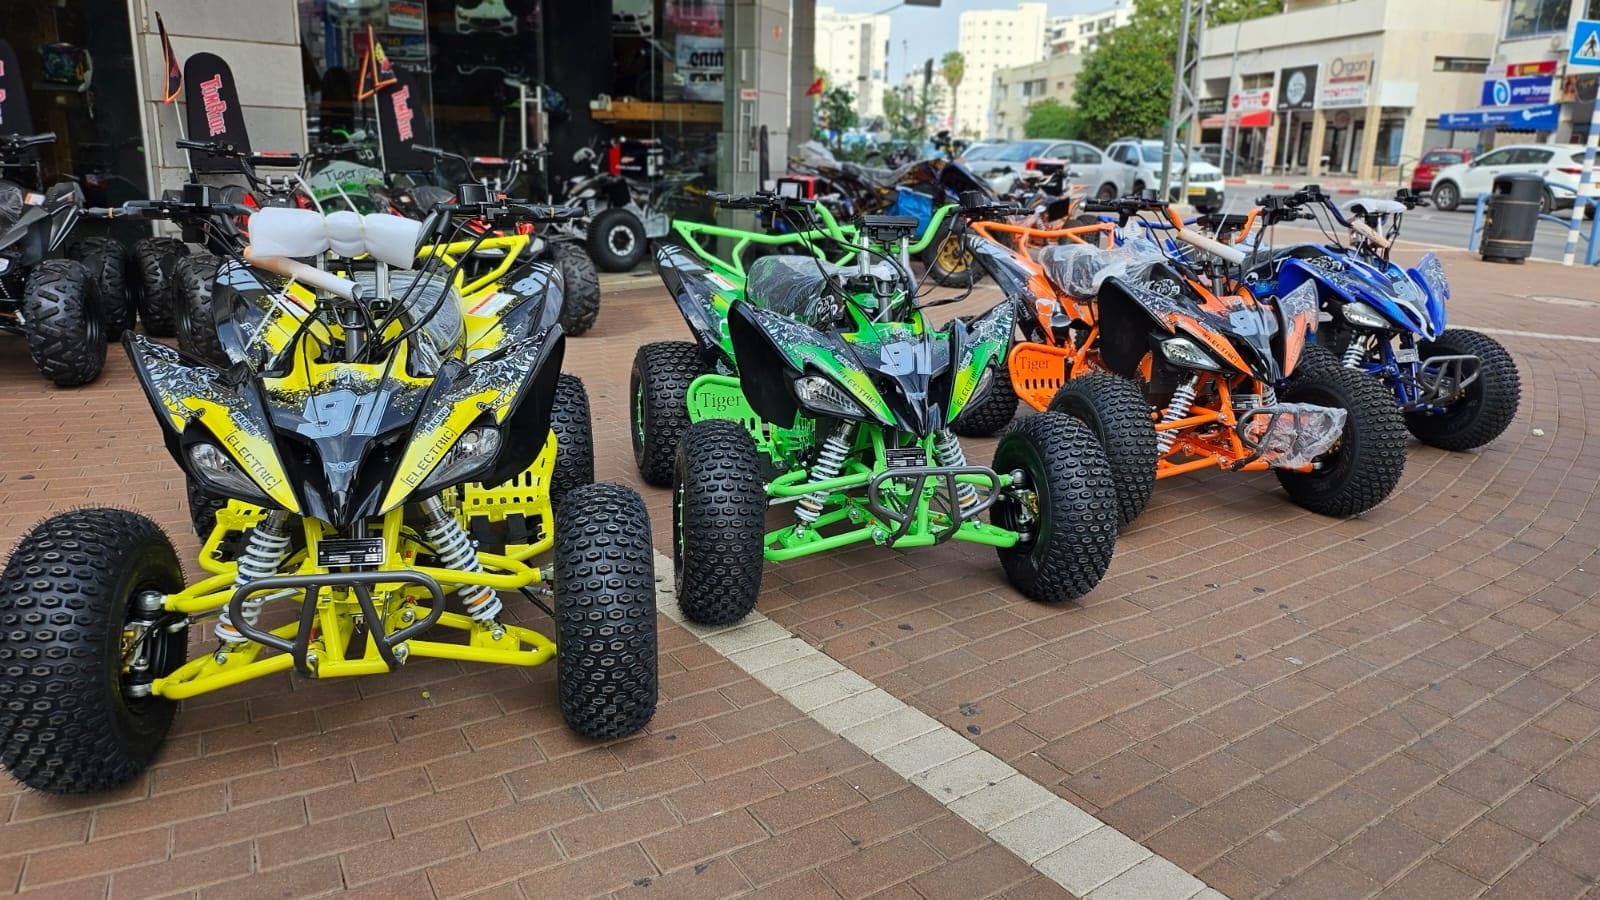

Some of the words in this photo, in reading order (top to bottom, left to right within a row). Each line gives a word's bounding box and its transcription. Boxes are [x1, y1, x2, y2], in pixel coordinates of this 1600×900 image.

[880, 341, 932, 376] 91
[1019, 356, 1049, 373] Tiger
[296, 389, 391, 440] 91
[700, 391, 743, 412] Tiger
[232, 412, 259, 436] RACING
[424, 406, 450, 434] RACING
